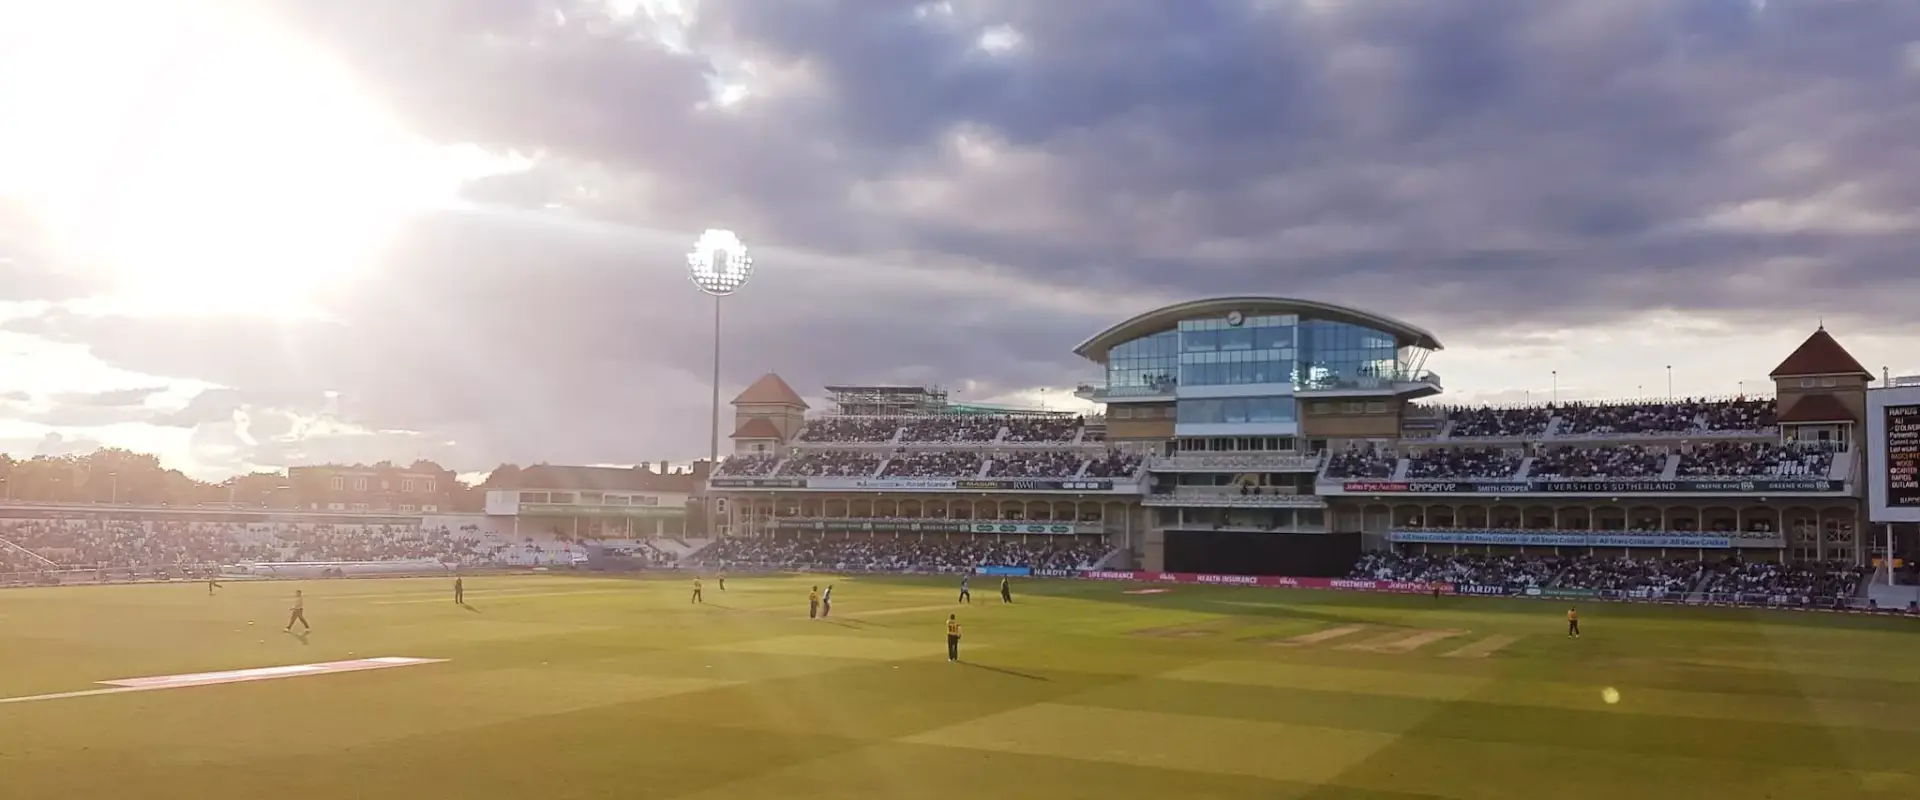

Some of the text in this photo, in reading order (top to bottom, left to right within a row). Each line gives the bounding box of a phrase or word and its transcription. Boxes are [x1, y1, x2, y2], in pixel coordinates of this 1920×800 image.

[1547, 483, 1676, 491] EVERSHEDS SUTHERLAND
[1222, 576, 1257, 584] INSURANCE
[1330, 580, 1376, 588] INVESTMENTS
[1408, 582, 1421, 591] Pye
